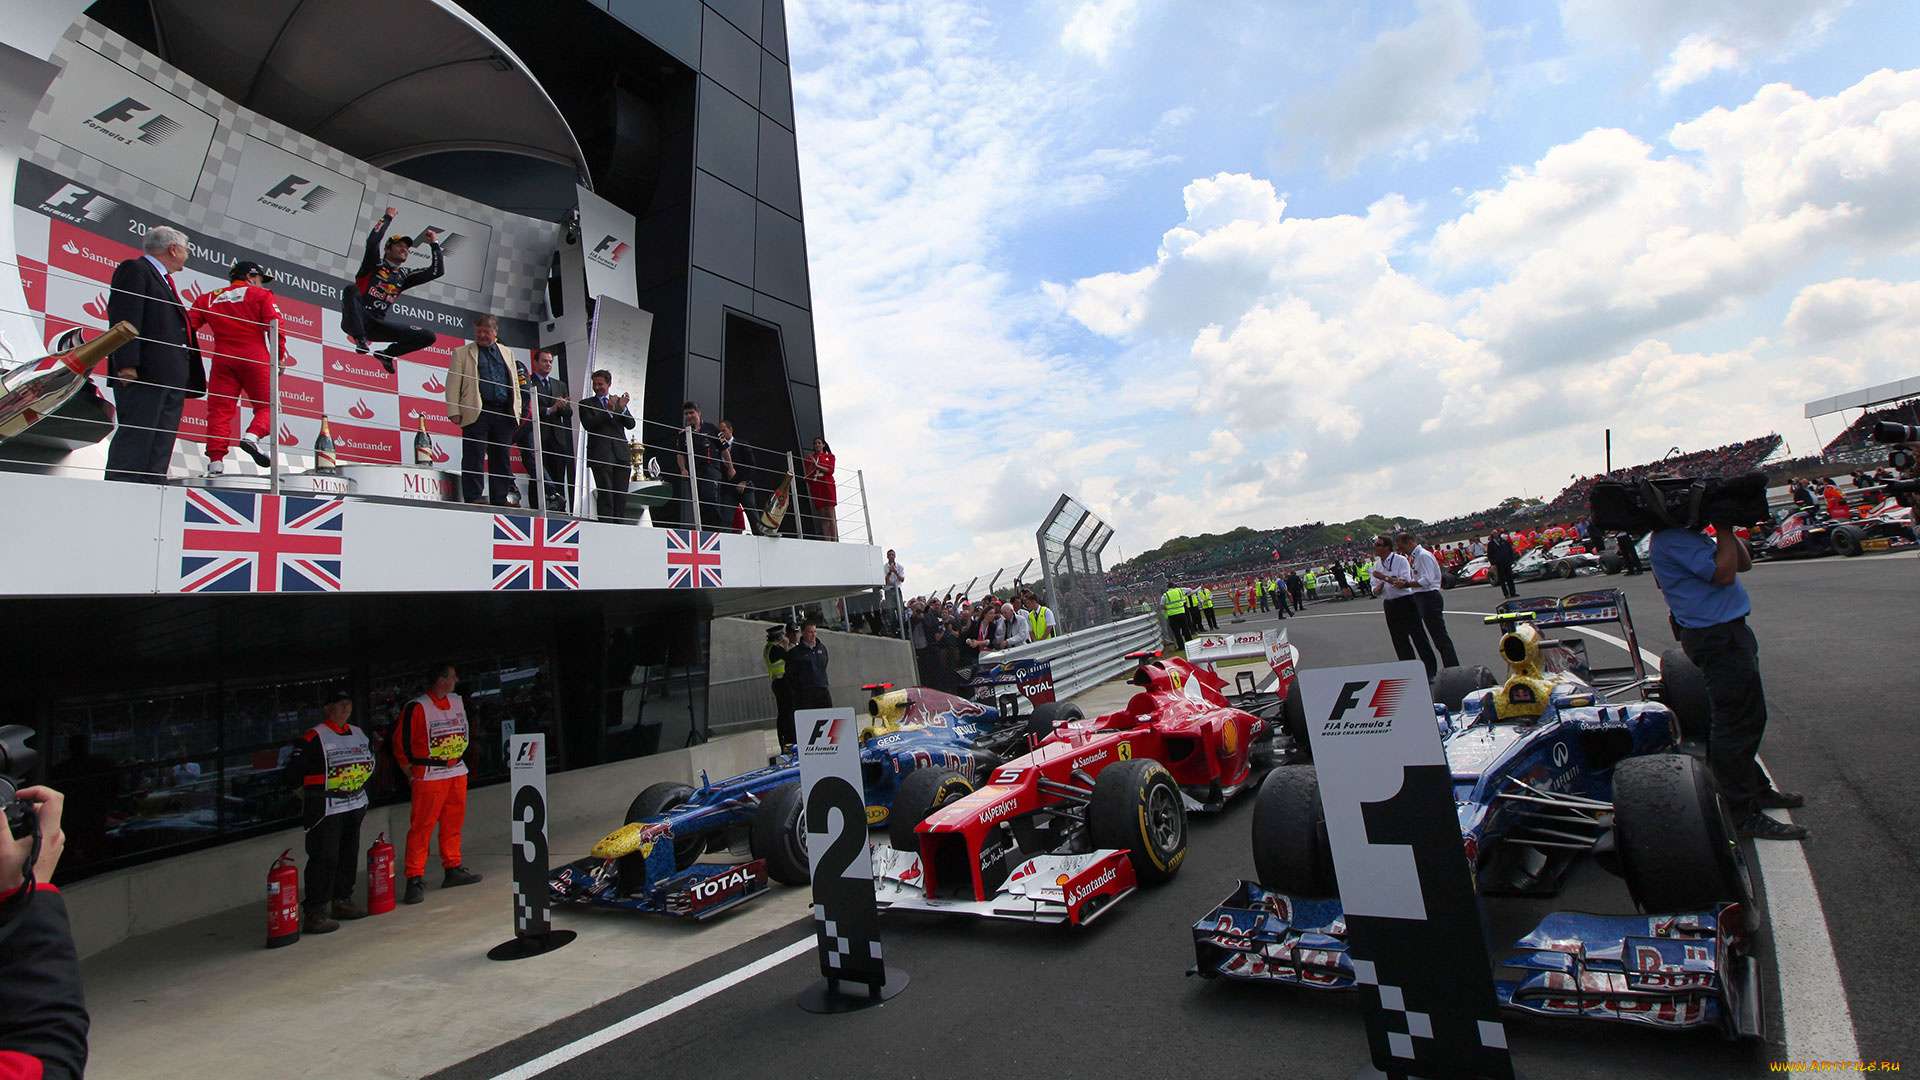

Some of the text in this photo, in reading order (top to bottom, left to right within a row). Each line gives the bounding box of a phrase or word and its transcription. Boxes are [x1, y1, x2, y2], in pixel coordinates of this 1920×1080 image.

[82, 118, 124, 143] Formula
[93, 96, 185, 147] F1
[45, 183, 119, 223] F1
[256, 197, 290, 213] Formula
[265, 173, 339, 214] F1
[38, 203, 75, 221] Formula
[593, 234, 631, 262] F1
[186, 241, 238, 268] RMULA
[258, 264, 336, 299] ANTANDER
[392, 303, 434, 322] GRAND
[437, 314, 464, 328] PRIX
[345, 363, 390, 380] Santander
[347, 438, 393, 452] Santander
[402, 473, 453, 497] MUMM
[1023, 680, 1053, 697] TOTAL
[1327, 678, 1412, 721] F1
[808, 718, 849, 746] F1
[1323, 719, 1393, 730] FIA Formula 1
[516, 741, 541, 762] F1
[877, 734, 902, 747] GEOX
[1078, 748, 1108, 768] Santander
[994, 768, 1024, 785] 5
[1143, 764, 1170, 785] ZERO
[512, 784, 549, 867] 3
[806, 776, 874, 879] 2
[1360, 764, 1480, 918] 1
[691, 868, 756, 901] TOTAL
[1076, 867, 1117, 901] Santander
